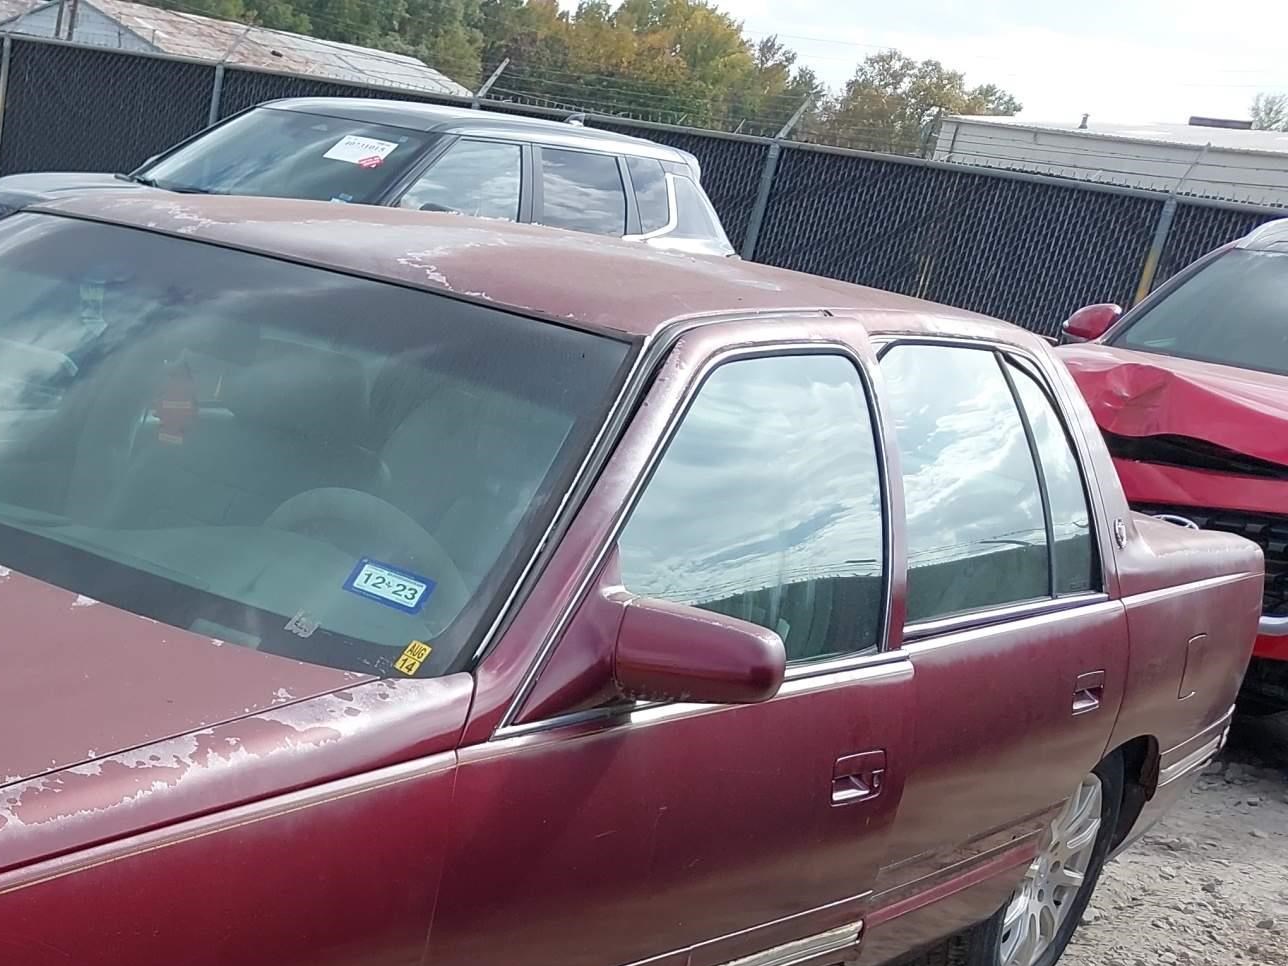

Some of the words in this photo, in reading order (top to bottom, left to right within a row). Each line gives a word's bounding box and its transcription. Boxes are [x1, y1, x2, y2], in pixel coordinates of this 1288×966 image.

[363, 572, 386, 589] 12
[392, 583, 418, 600] 23
[406, 642, 427, 659] AUG
[399, 658, 417, 672] 14
